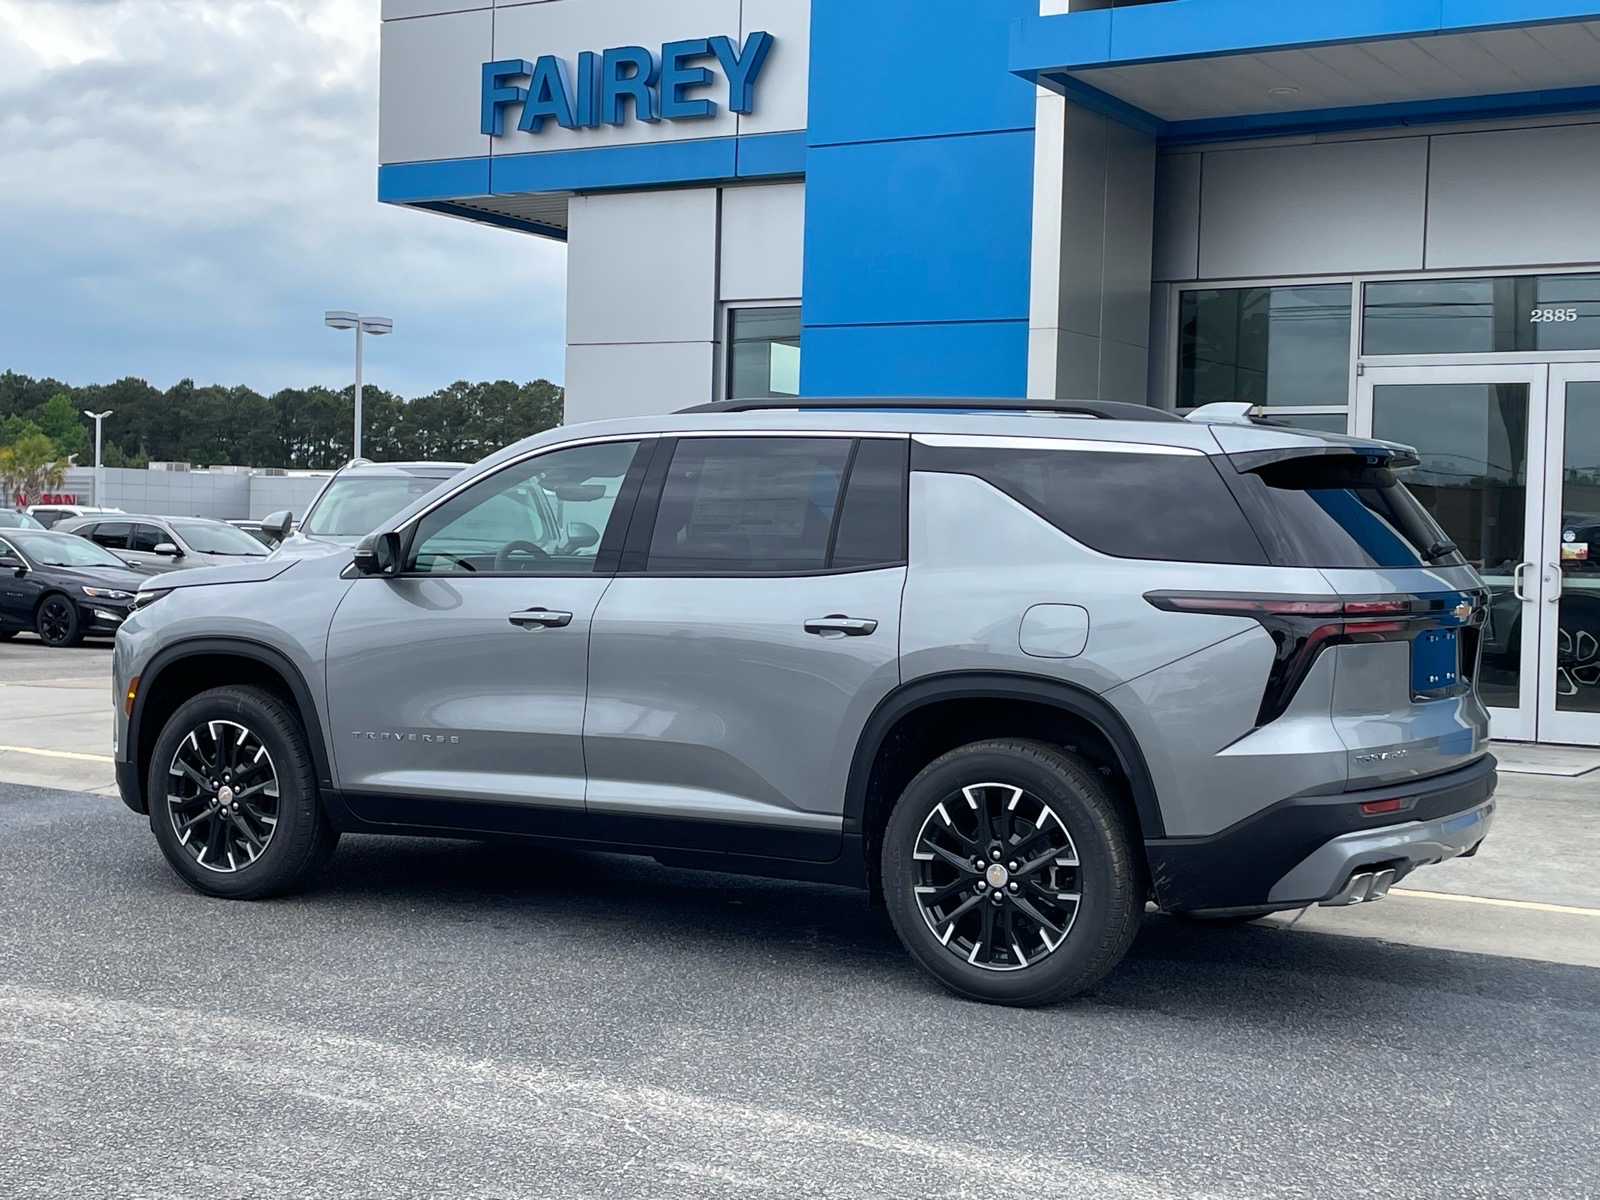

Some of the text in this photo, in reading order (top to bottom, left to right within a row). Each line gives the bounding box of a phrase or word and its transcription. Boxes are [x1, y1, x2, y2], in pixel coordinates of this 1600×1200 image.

[480, 31, 774, 137] FAIREY
[1530, 309, 1578, 322] 2885
[15, 493, 76, 506] NSAN
[352, 731, 460, 744] TRAVERSE
